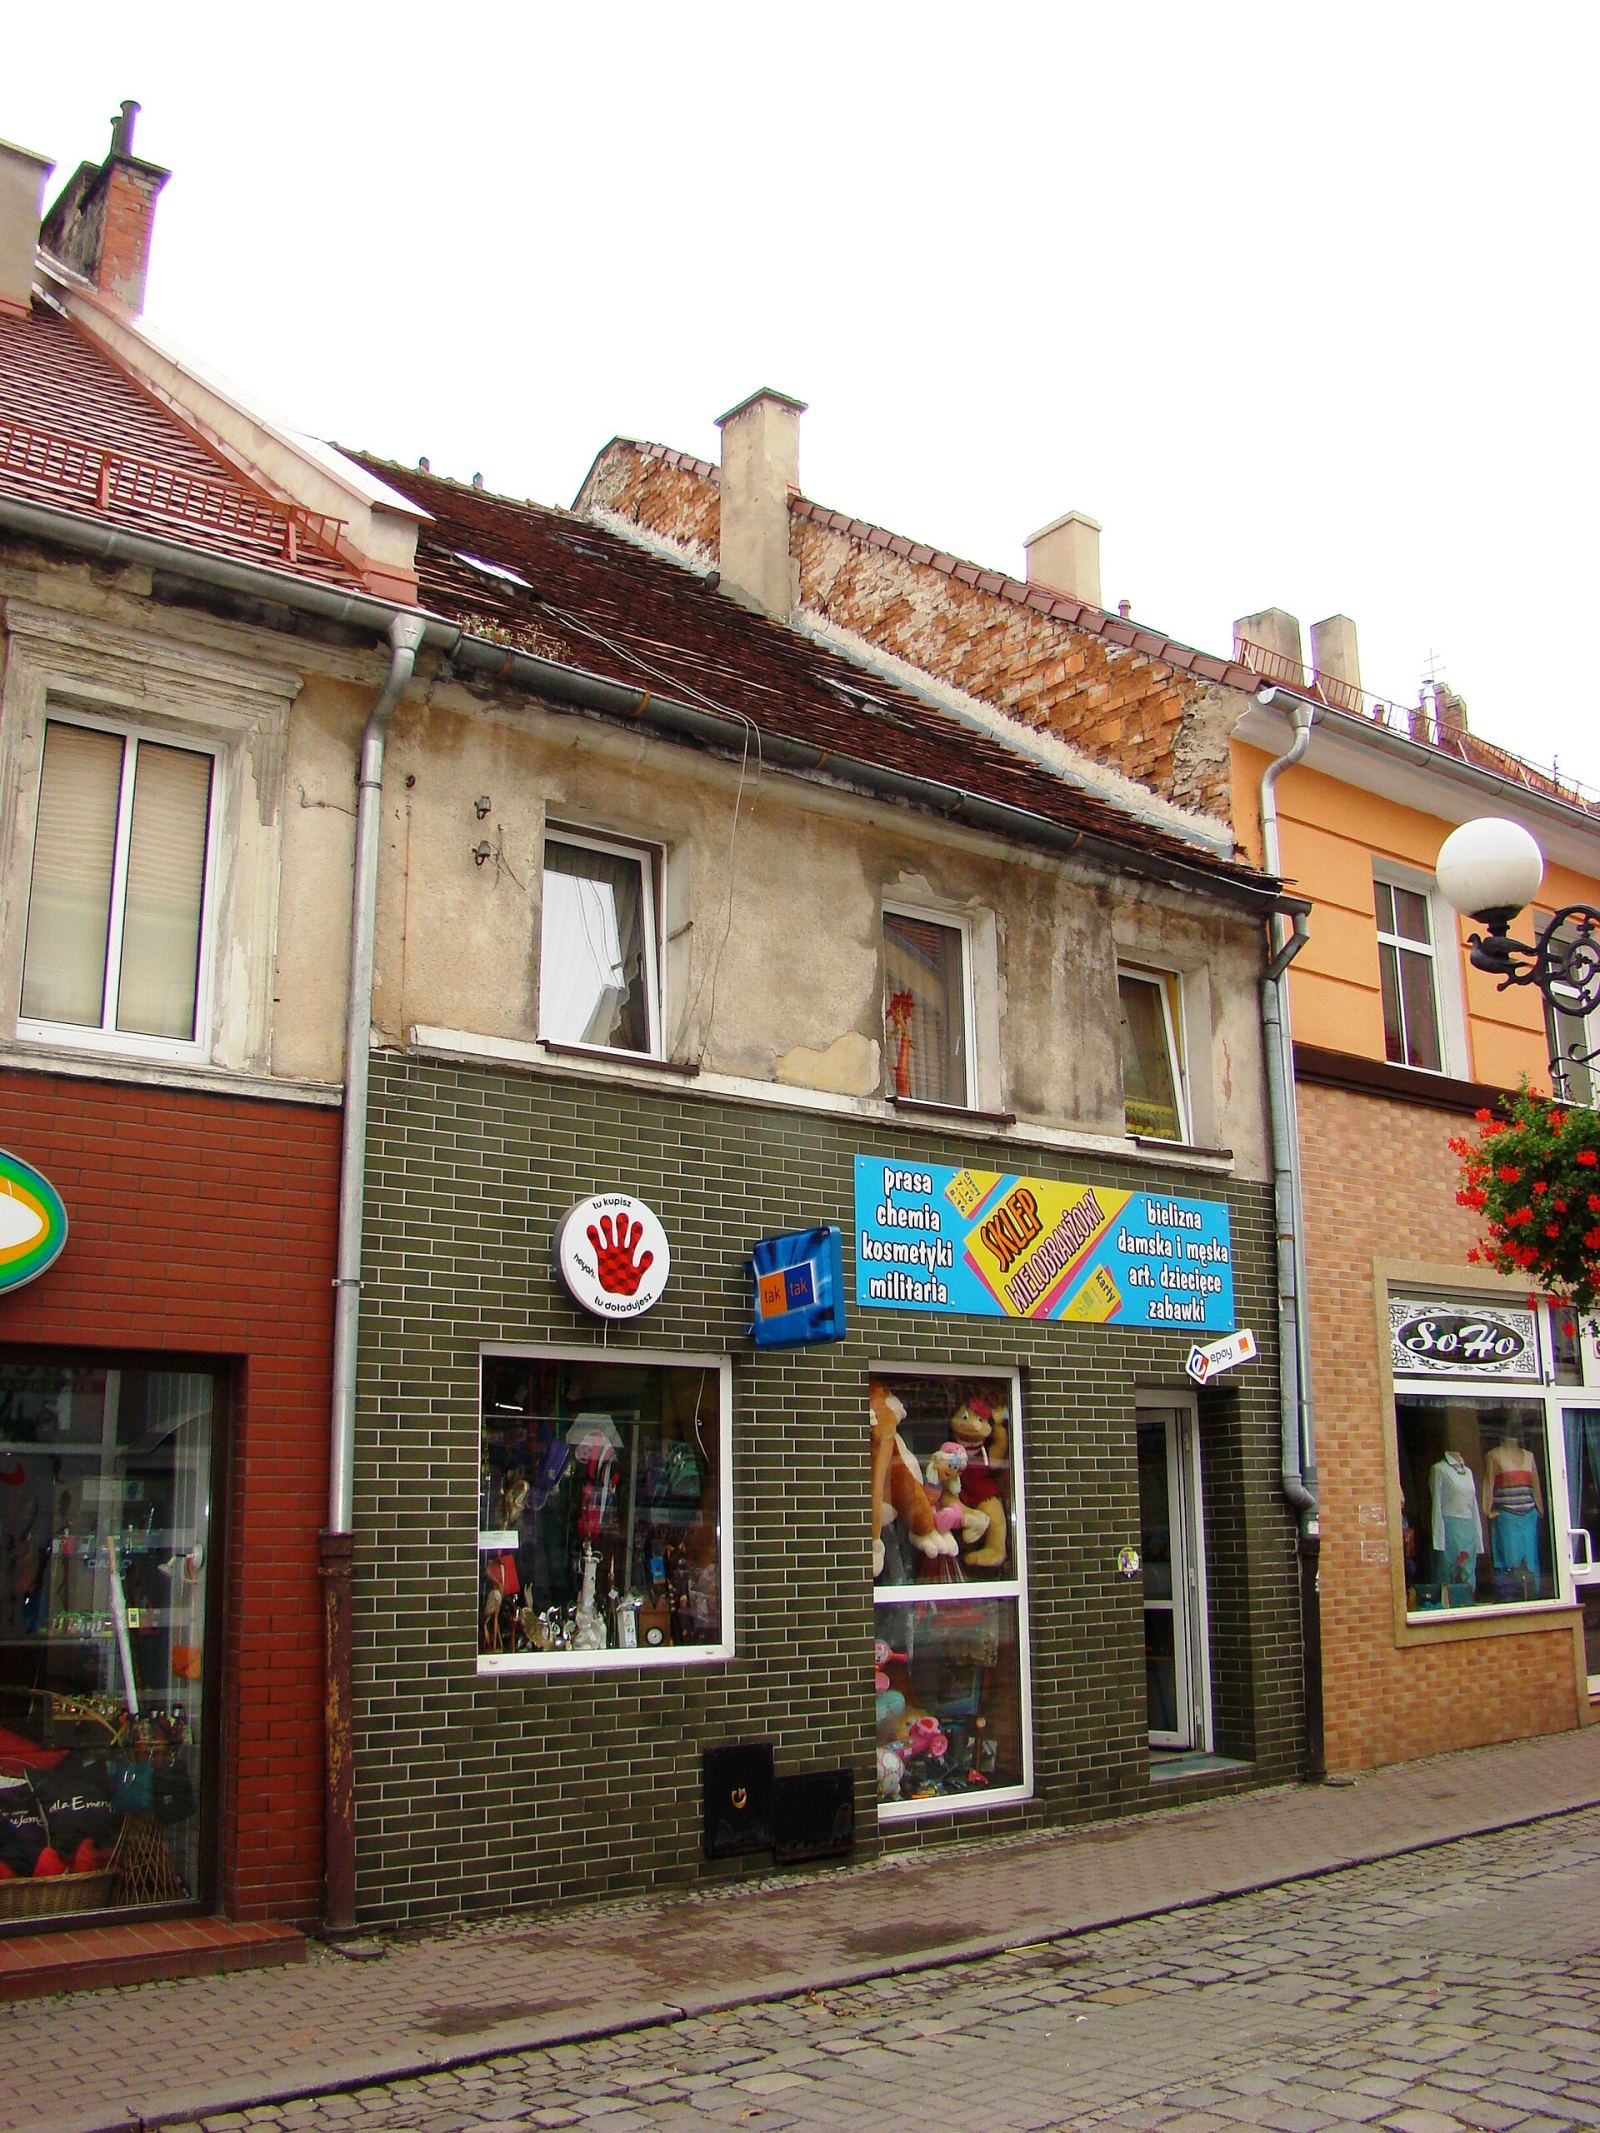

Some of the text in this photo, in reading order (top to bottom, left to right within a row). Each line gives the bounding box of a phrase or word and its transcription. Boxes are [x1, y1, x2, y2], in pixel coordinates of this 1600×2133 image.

[884, 1166, 932, 1196] prasa
[603, 1197, 632, 1208] kupisz
[876, 1197, 941, 1232] chemia
[1146, 1198, 1202, 1230] bielizna
[980, 1188, 1043, 1272] SKLEP
[1117, 1226, 1230, 1268] damska i męska
[861, 1230, 954, 1275] kosmetyki
[1004, 1188, 1105, 1314] WIELOBRANŻOWY
[764, 1277, 808, 1304] tak tak
[868, 1270, 948, 1305] militaria
[1096, 1270, 1115, 1304] karty
[1128, 1262, 1223, 1298] art. dziecięce
[594, 1296, 604, 1307] tu
[1148, 1293, 1206, 1323] zabawki
[1210, 1347, 1233, 1364] epay
[1406, 1321, 1519, 1359] SoHo
